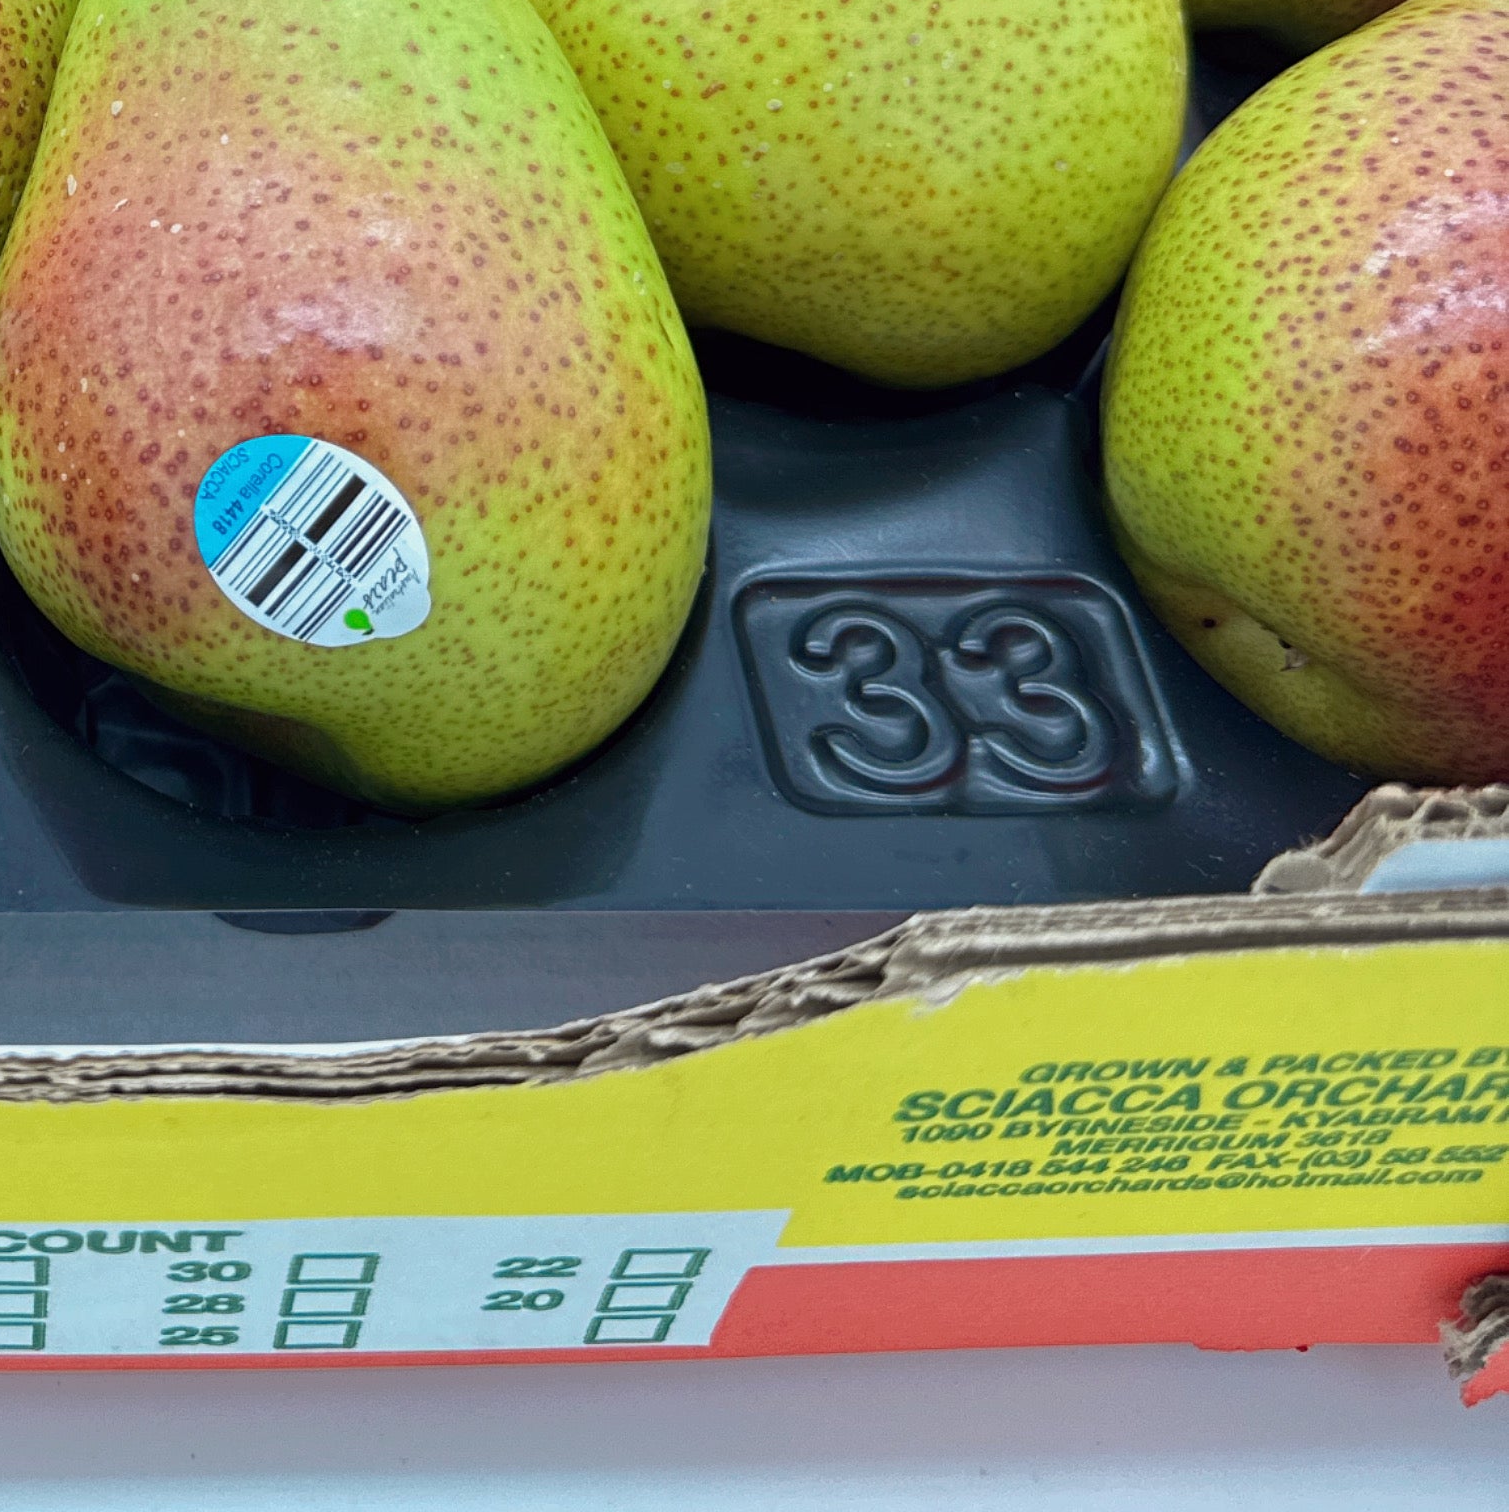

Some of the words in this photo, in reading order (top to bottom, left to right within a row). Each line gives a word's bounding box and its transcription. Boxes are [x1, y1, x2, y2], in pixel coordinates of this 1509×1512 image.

[200, 447, 250, 501] SCIACCA
[242, 453, 284, 500] Corella
[212, 499, 244, 535] 4418
[362, 546, 408, 609] pears
[789, 599, 1113, 788] 33
[1019, 1057, 1210, 1083] GROWN
[1214, 1057, 1249, 1076] &
[1259, 1048, 1458, 1075] PACKED
[893, 1083, 1202, 1123] SCIACCA
[1000, 1114, 1248, 1138] BYRNESIDE
[1280, 1106, 1493, 1128] KYABRAM
[1050, 1133, 1289, 1156] MERRIGUM
[823, 1160, 1033, 1183] MOB-0418
[1037, 1158, 1110, 1175] 544
[1206, 1149, 1372, 1171] FAX-(03)
[1377, 1147, 1431, 1164] 58
[893, 1170, 1482, 1200] sciaccaorchards@hotmail.com
[166, 1261, 251, 1282] 30
[493, 1256, 581, 1277] 22
[162, 1294, 245, 1314] 28
[480, 1290, 564, 1310] 20
[159, 1326, 239, 1346] 25
